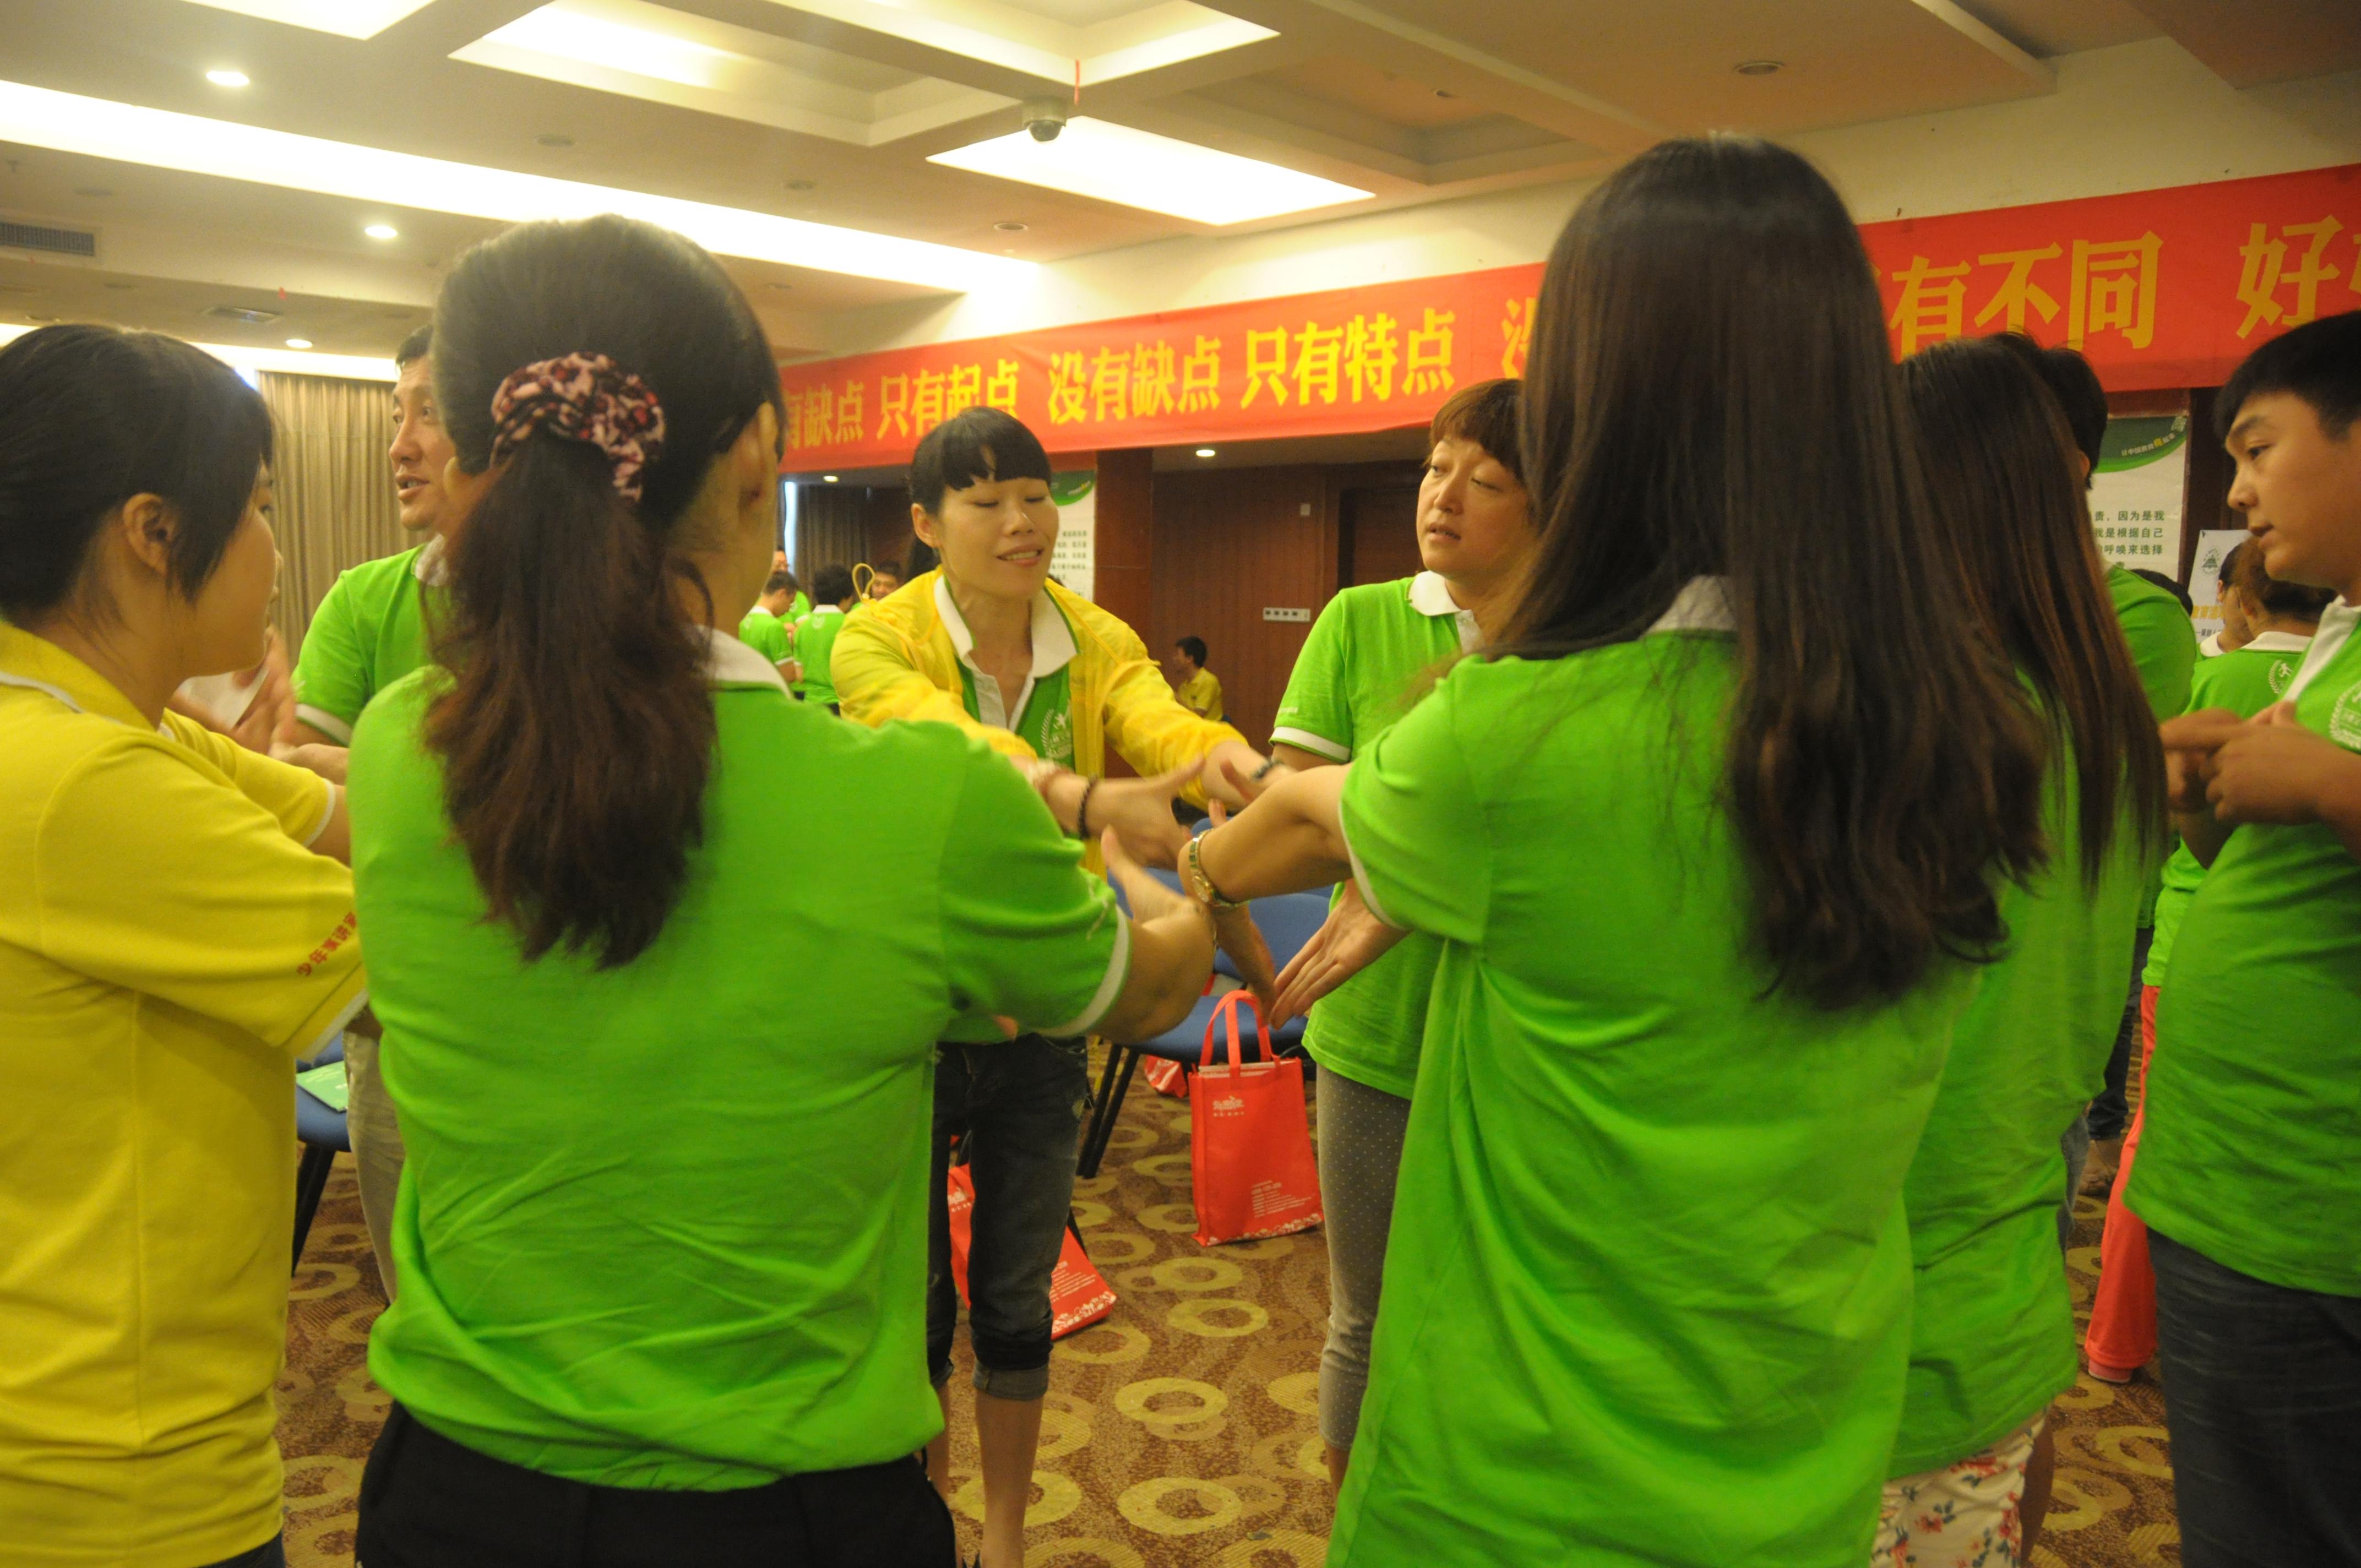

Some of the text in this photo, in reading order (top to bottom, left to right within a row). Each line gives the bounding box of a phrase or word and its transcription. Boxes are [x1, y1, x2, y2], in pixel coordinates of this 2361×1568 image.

[1046, 335, 1221, 426] 没有缺点
[1240, 307, 1456, 410] 只有特点
[1872, 230, 2164, 363] 有不同
[2236, 214, 2361, 339] 好
